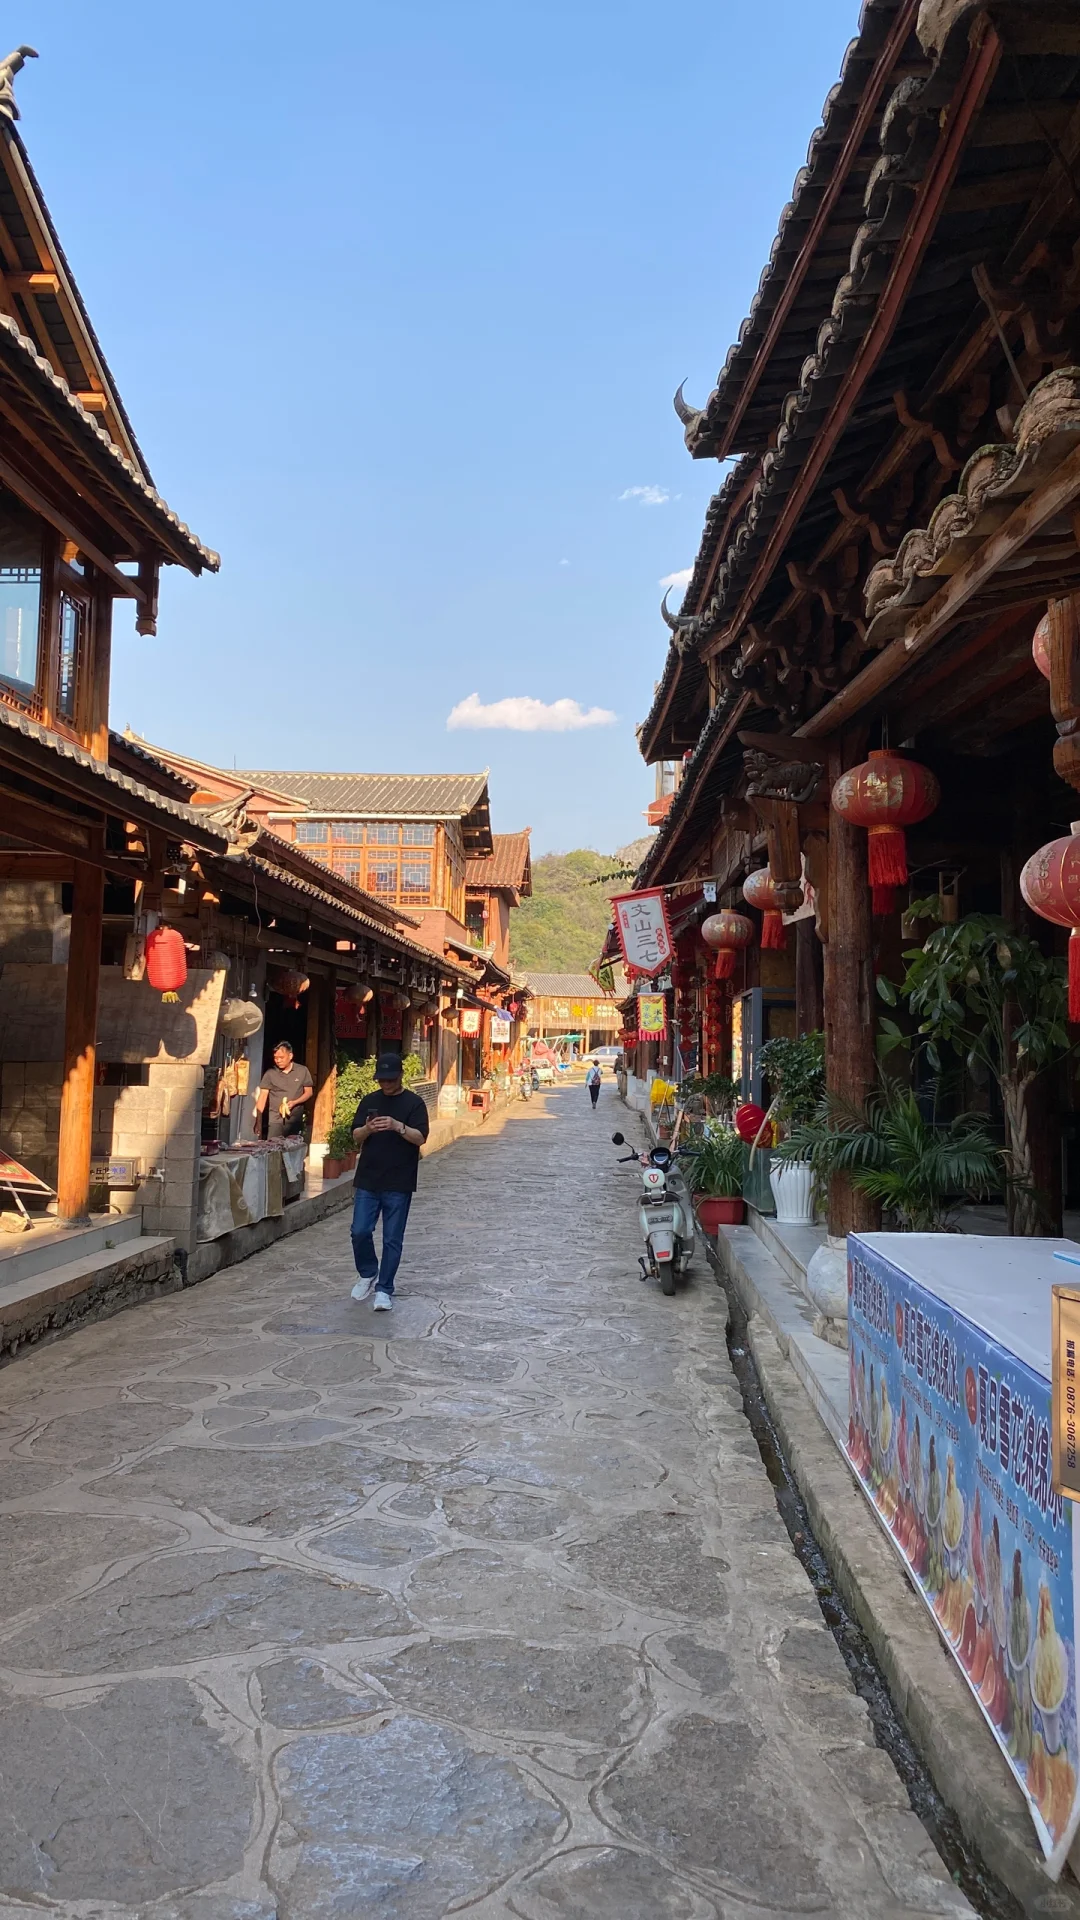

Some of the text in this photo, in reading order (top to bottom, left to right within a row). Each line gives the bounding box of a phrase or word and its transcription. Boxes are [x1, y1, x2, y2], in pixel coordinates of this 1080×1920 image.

[631, 904, 659, 962] 文山三七
[903, 1297, 960, 1412] 夏日雪花绵绵冰
